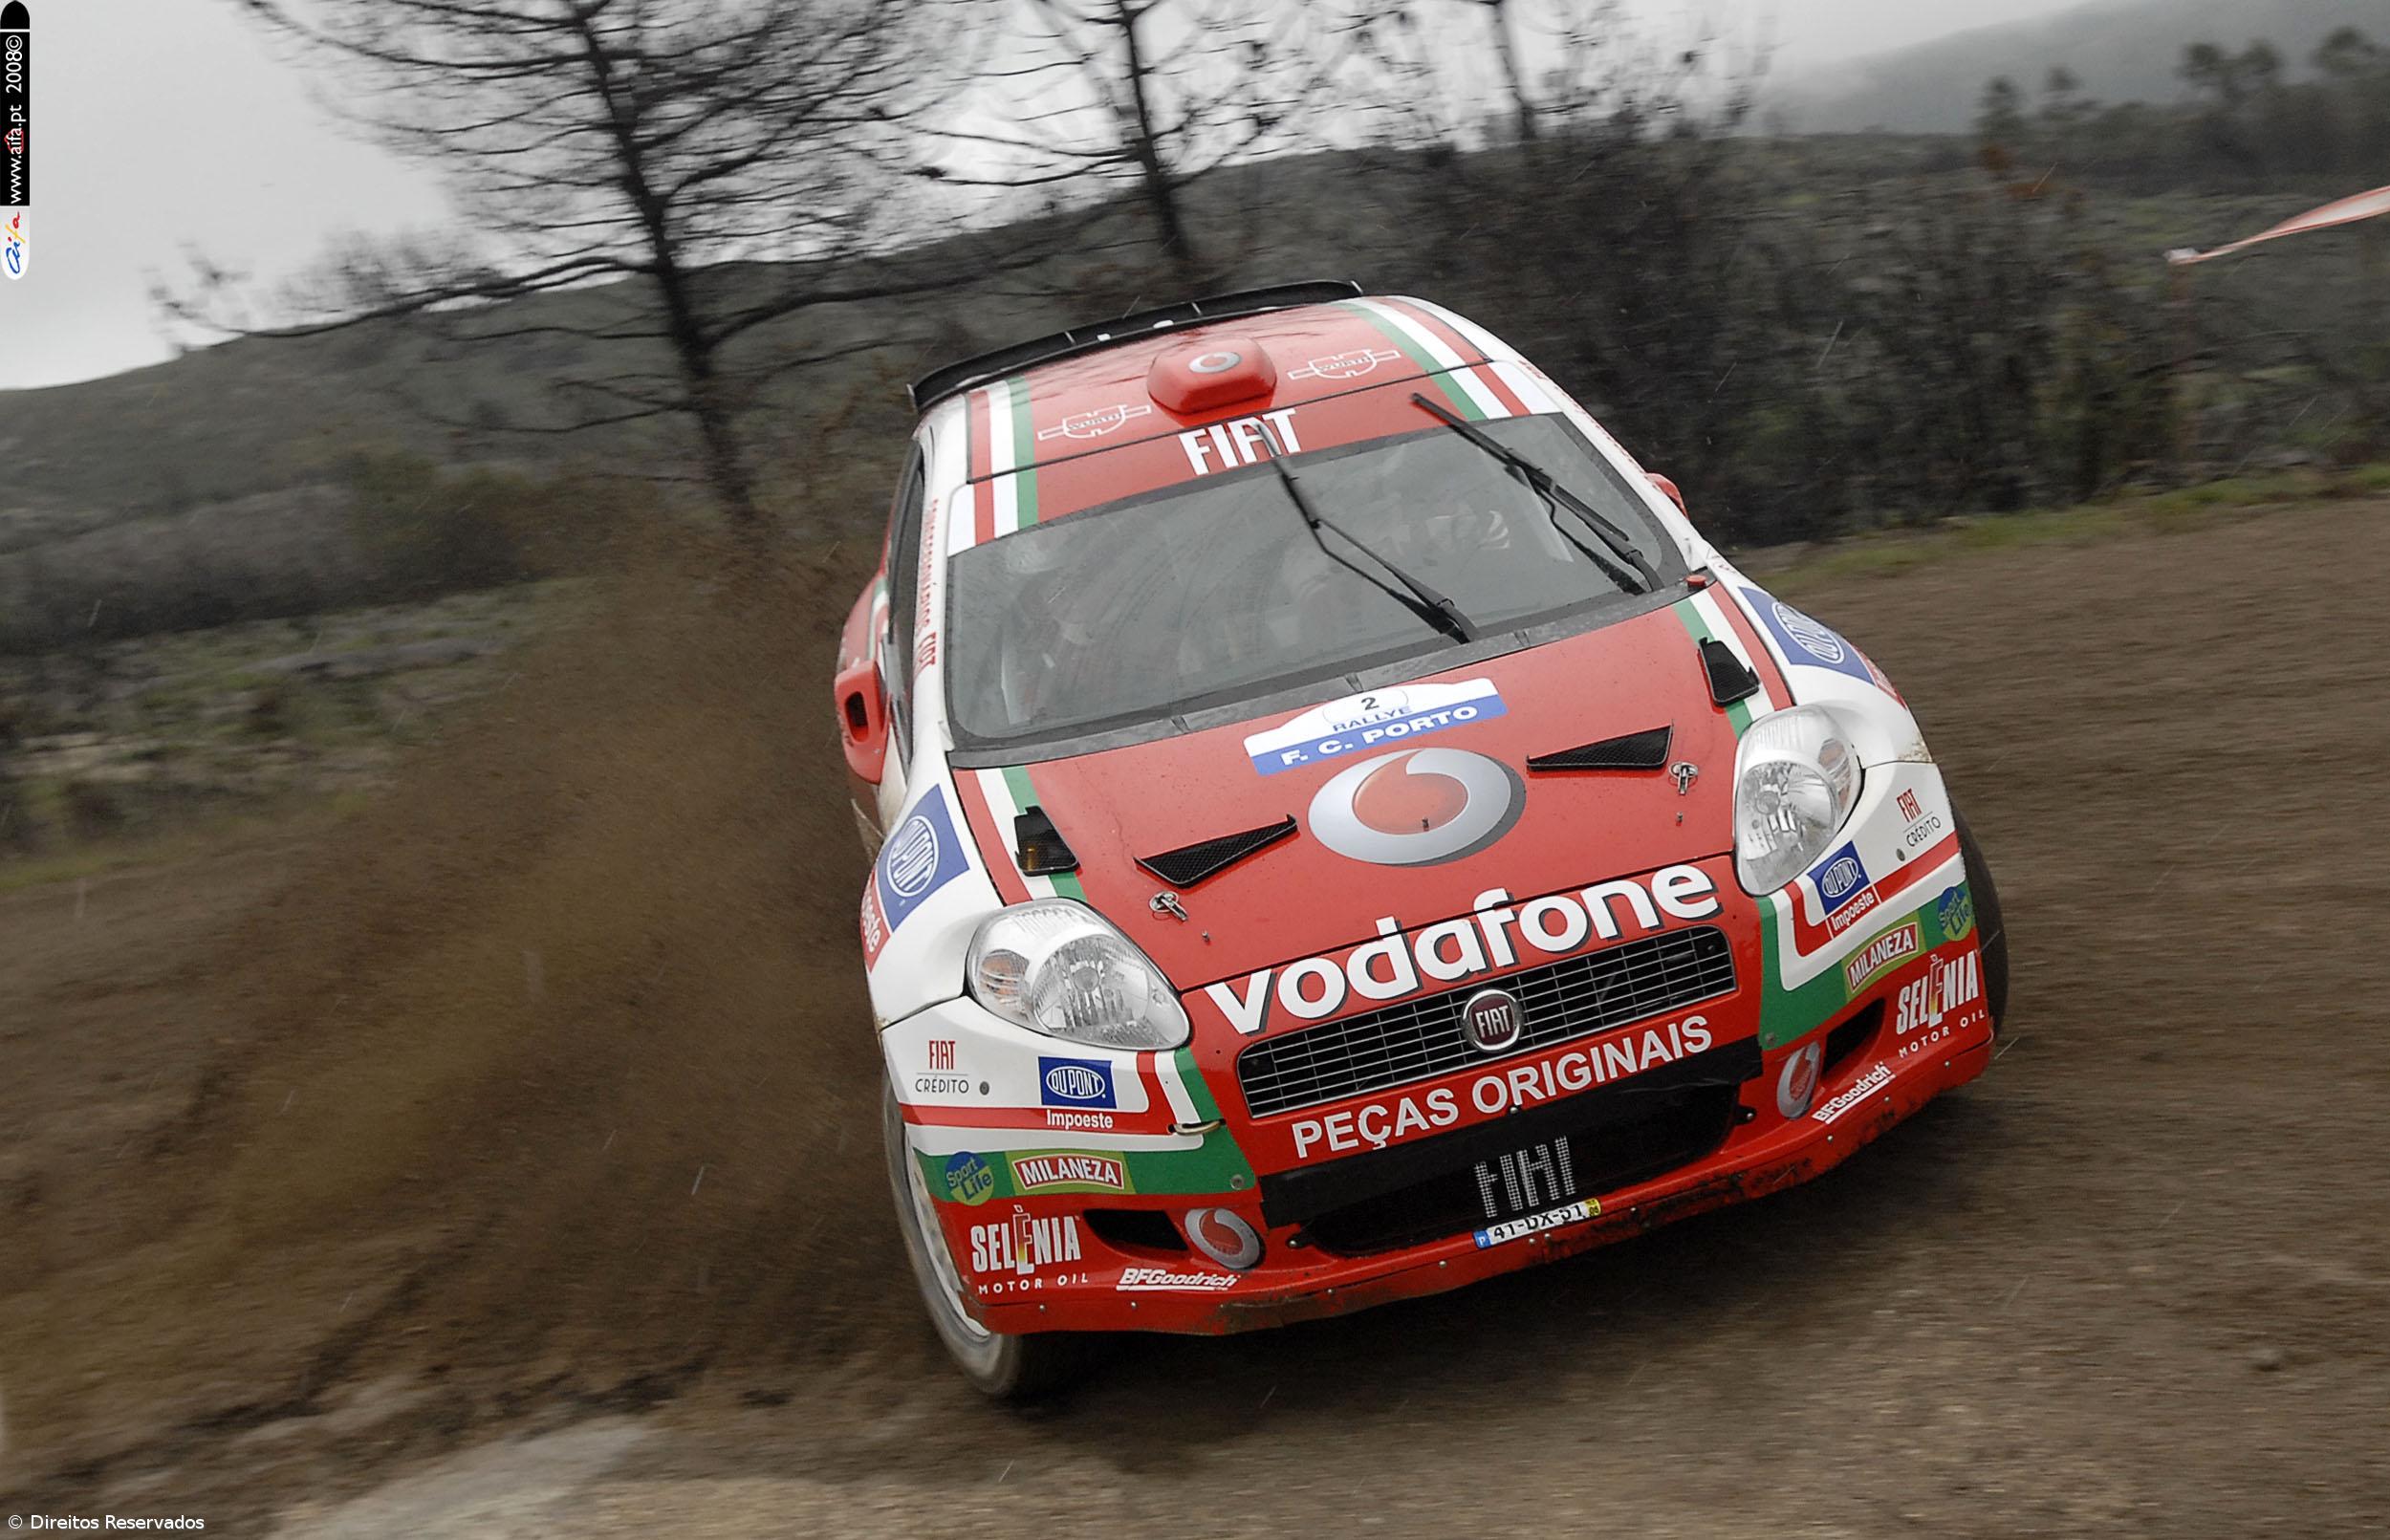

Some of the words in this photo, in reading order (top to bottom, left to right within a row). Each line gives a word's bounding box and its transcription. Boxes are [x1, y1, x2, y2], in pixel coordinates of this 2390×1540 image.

[1178, 408, 1301, 476] FIAT
[1333, 705, 1413, 732] RALLYE
[1361, 697, 1380, 710] 2
[1280, 748, 1309, 766] F.
[1317, 740, 1354, 755] C.
[1361, 705, 1478, 745] PORTO
[1897, 789, 1922, 822] FIAT
[1830, 891, 1875, 932] Impoeste
[1204, 864, 1722, 1036] vodafone
[1850, 929, 1914, 987] MILANEZA
[1474, 1003, 1511, 1039] FIAT
[1899, 1026, 1950, 1059] MOTOR
[1960, 1009, 1986, 1029] OIL
[928, 1040, 956, 1070] FIAT
[915, 1074, 969, 1094] CRÉDITO
[1291, 1087, 1460, 1160] PEÇAS
[1471, 1014, 1713, 1115] ORIGINAIS
[1813, 1063, 1893, 1123] BFGoodrich
[1046, 1109, 1114, 1130] Impoeste
[946, 1156, 978, 1189] Sport
[963, 1171, 992, 1201] Life
[1020, 1156, 1119, 1185] MILANEZA
[979, 1279, 1043, 1294] MOTOR
[1057, 1273, 1089, 1286] OIL
[1117, 1268, 1239, 1289] BFGoodrich
